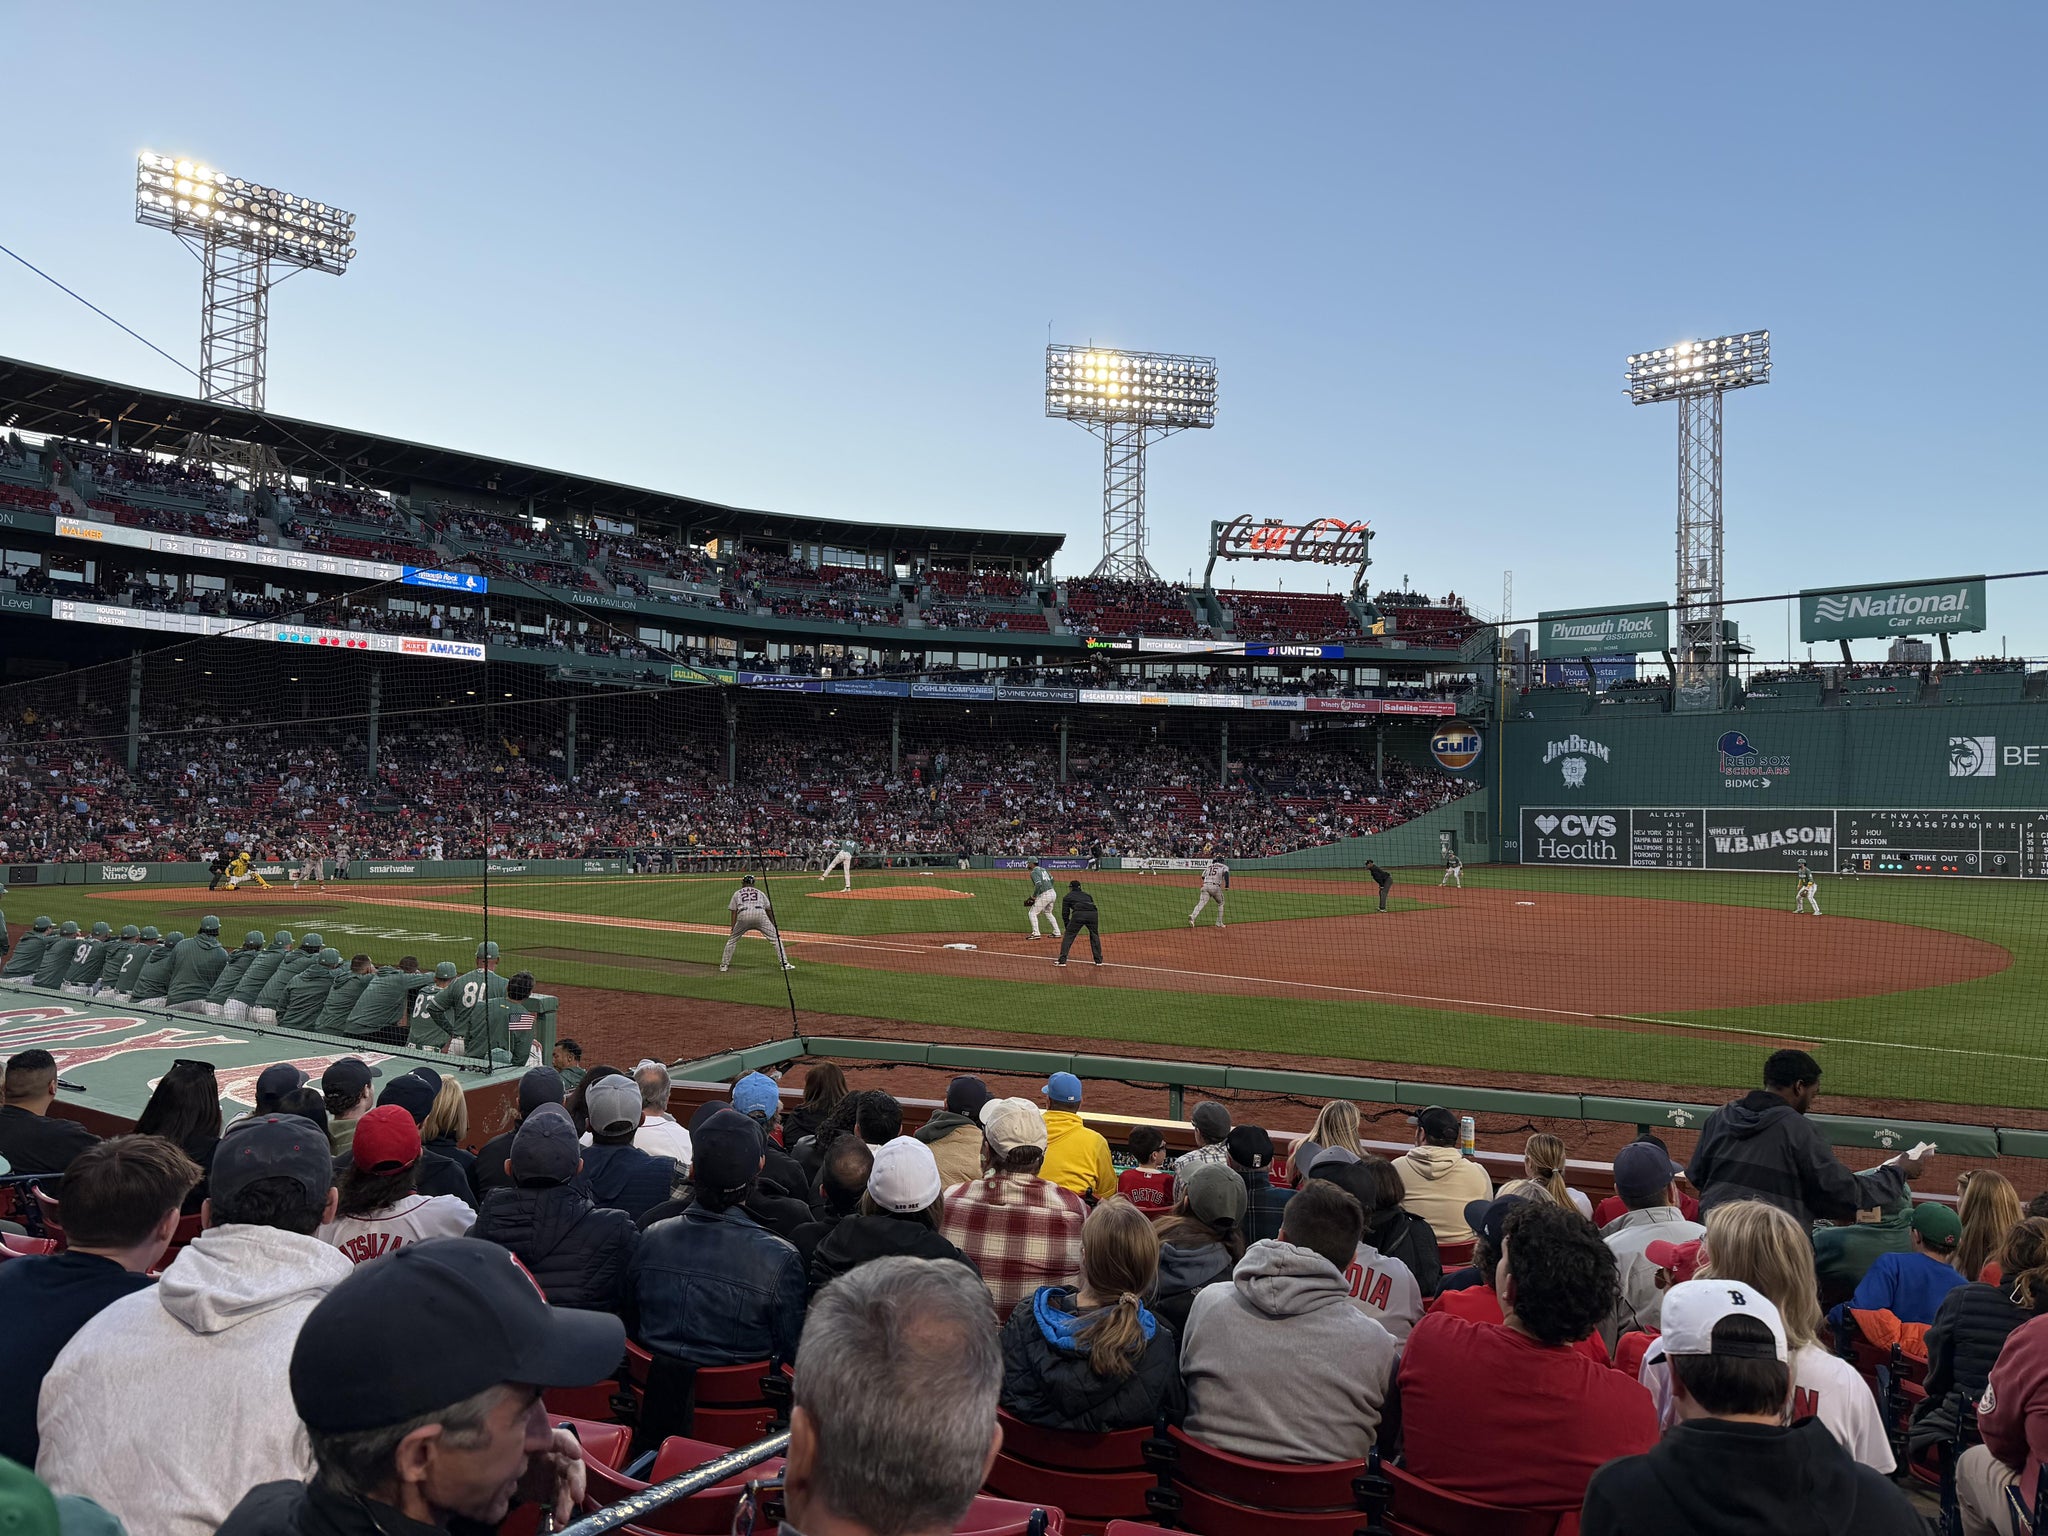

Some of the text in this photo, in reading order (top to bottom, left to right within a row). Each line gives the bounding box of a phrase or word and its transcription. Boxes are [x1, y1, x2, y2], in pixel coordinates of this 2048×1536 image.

[1265, 518, 1283, 526] ENJOY
[61, 525, 103, 539] WALKER
[1219, 514, 1371, 563] Coca-Cola
[166, 543, 177, 551] 32
[199, 546, 211, 555] 131
[227, 549, 247, 559] .293
[259, 554, 277, 563] .366
[288, 559, 307, 568] .552
[319, 563, 335, 571] .918
[379, 570, 389, 578] 24
[2, 596, 33, 610] Level
[601, 598, 637, 610] PAVILION
[1848, 589, 1968, 618] National
[62, 602, 127, 616] 50 HOUSTON
[62, 612, 124, 625] 64 BOSTON
[1889, 613, 1962, 627] Car Rental
[285, 625, 305, 634] BALL
[1551, 616, 1654, 640] Plymouth Rock
[317, 629, 341, 638] STRIKE
[350, 632, 364, 640] OUT
[1605, 631, 1658, 641] assurance
[429, 643, 482, 657] AMAZING
[1146, 642, 1163, 650] PITCH
[1164, 642, 1182, 650] BREAK
[1280, 646, 1322, 656] UNITED
[1565, 667, 1583, 679] Your
[913, 685, 992, 694] COGHLIN COMPANIES
[1008, 689, 1048, 698] VINEYARD
[1432, 736, 1478, 753] Gulf
[1725, 755, 1791, 767] RED SOX
[1725, 766, 1791, 776] SCHOLARS
[1725, 779, 1760, 788] BIDMC
[1561, 814, 1617, 837] CVS
[1968, 822, 1977, 830] 10
[1986, 822, 1992, 830] R
[1708, 828, 1745, 836] WHO BUT
[1504, 841, 1519, 849] 310
[1537, 838, 1618, 860] Health
[1810, 850, 1829, 858] 1898
[1909, 854, 1938, 862] STRIKE
[102, 865, 129, 873] Ninety
[369, 865, 416, 874] smartwater
[502, 865, 527, 873] TICKET
[1208, 867, 1219, 876] 15
[102, 872, 128, 880] Nine
[741, 892, 758, 903] 23
[74, 944, 93, 964] 91
[120, 953, 134, 972] 2
[1132, 1188, 1164, 1205] BETTS
[339, 1233, 414, 1265] ATSUZA
[1727, 1290, 1747, 1306] B
